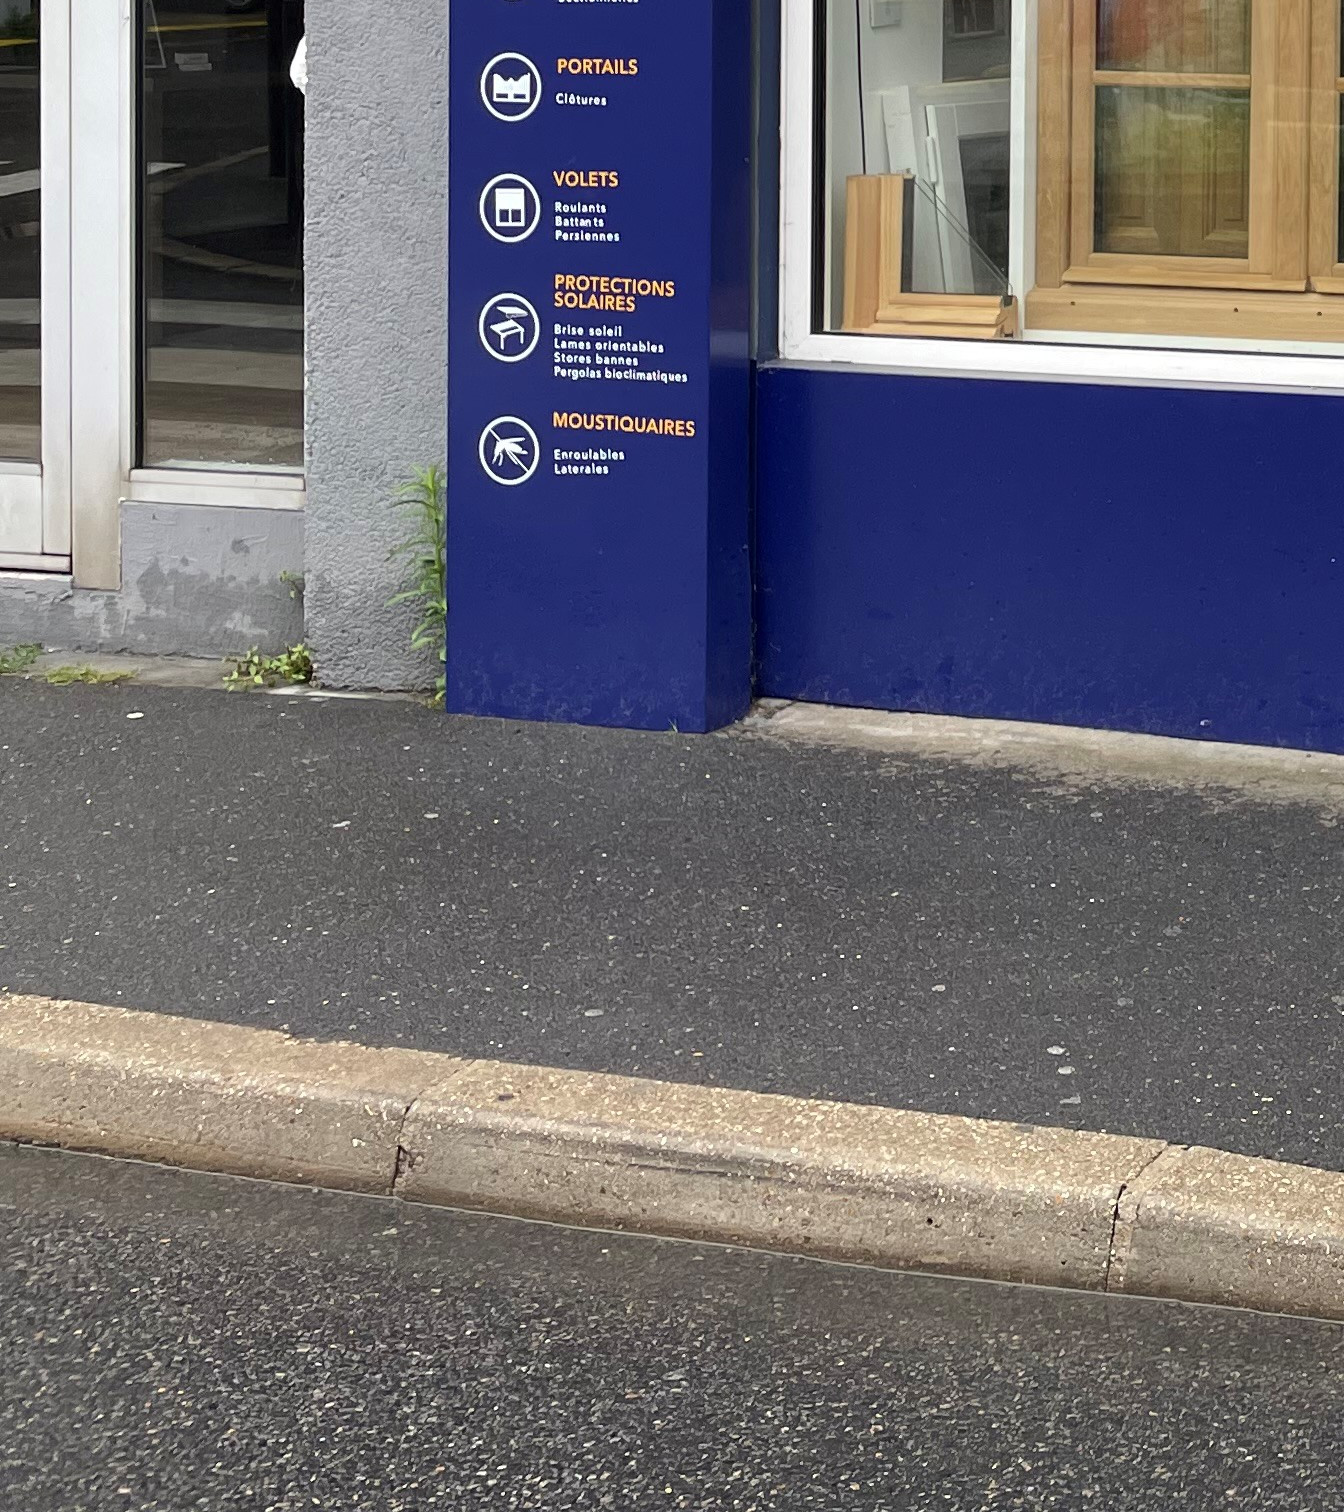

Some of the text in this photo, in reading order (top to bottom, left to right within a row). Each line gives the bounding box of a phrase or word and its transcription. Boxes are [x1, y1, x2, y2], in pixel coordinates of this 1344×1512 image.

[557, 57, 639, 75] PORTAILS
[555, 92, 607, 106] Clôtures
[552, 170, 619, 187] VOLETS
[554, 201, 607, 214] Roulants
[555, 215, 605, 227] Battants
[555, 229, 620, 242] Persiennes
[554, 273, 675, 297] PROTECTIONS
[554, 291, 636, 312] SOLAIRES
[554, 323, 623, 337] Brise soleil
[554, 337, 664, 354] Lames orientables
[553, 351, 639, 366] Stores bannes
[553, 365, 688, 384] Pergolas bioclimatiques
[552, 411, 696, 437] MOUSTIQUAIRES
[553, 448, 625, 460] Enroulables
[554, 462, 609, 475] Laterales
